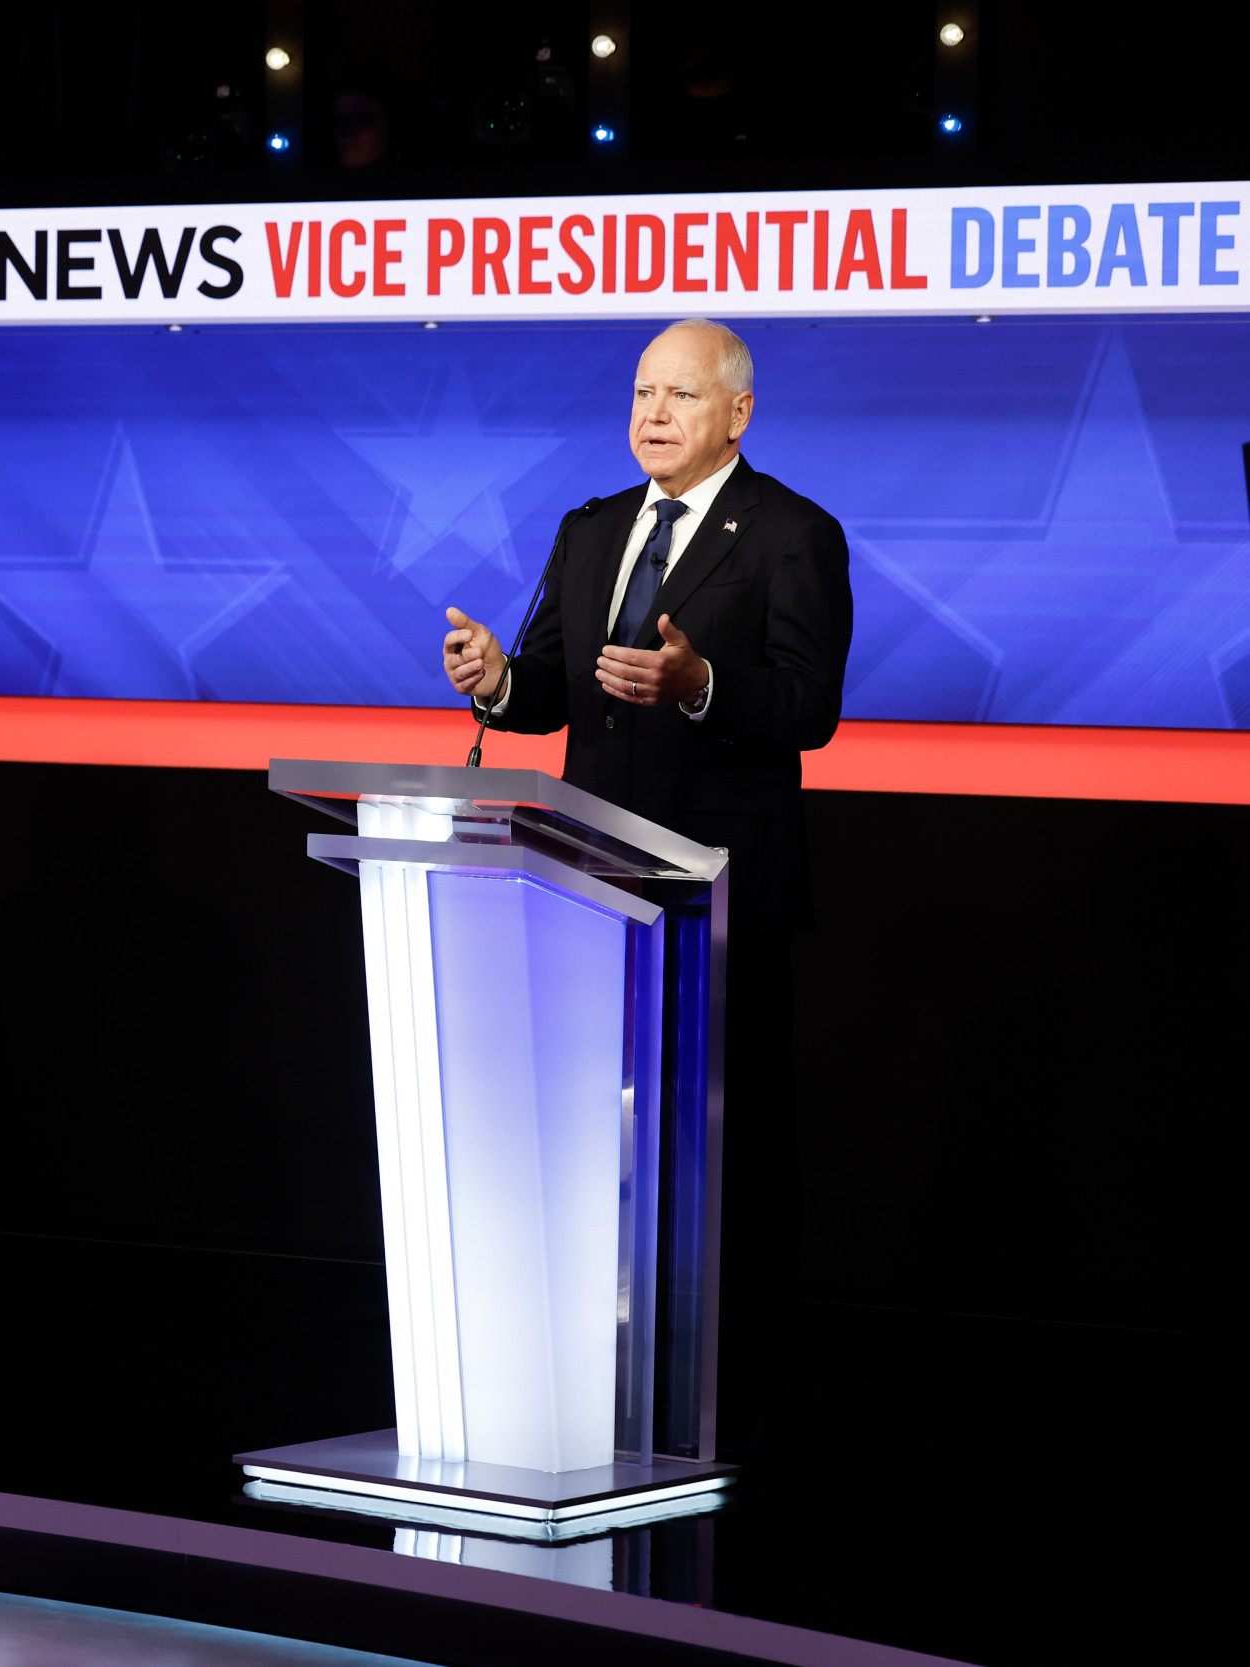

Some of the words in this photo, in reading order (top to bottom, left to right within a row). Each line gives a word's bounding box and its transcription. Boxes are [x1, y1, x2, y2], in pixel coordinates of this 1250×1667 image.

[264, 218, 407, 299] VICE
[427, 208, 928, 297] PRESIDENTIAL
[950, 200, 1241, 289] DEBATE
